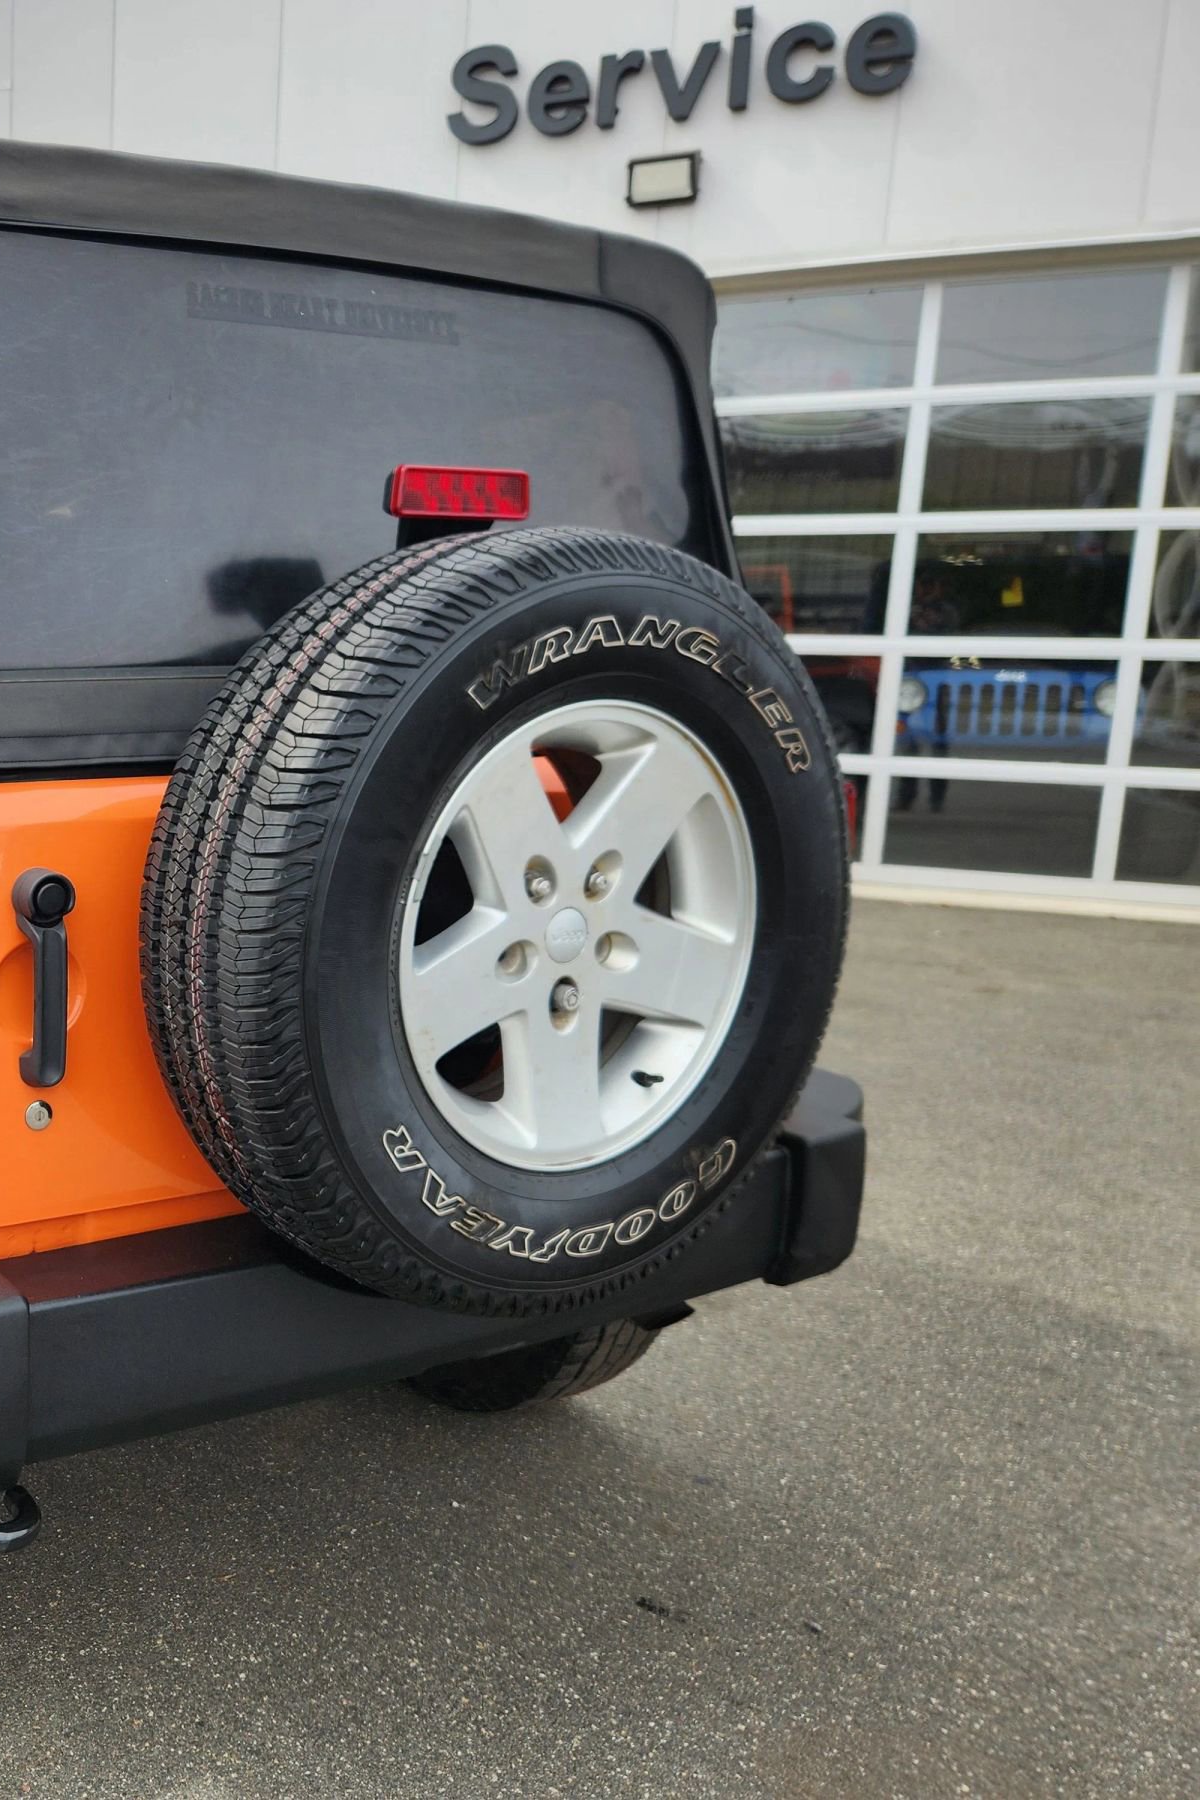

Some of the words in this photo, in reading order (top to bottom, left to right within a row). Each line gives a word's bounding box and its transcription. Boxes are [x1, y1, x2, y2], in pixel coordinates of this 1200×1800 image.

[447, 6, 918, 146] Service
[465, 614, 813, 774] WRANGLER
[382, 1125, 737, 1263] GOODYEAR
